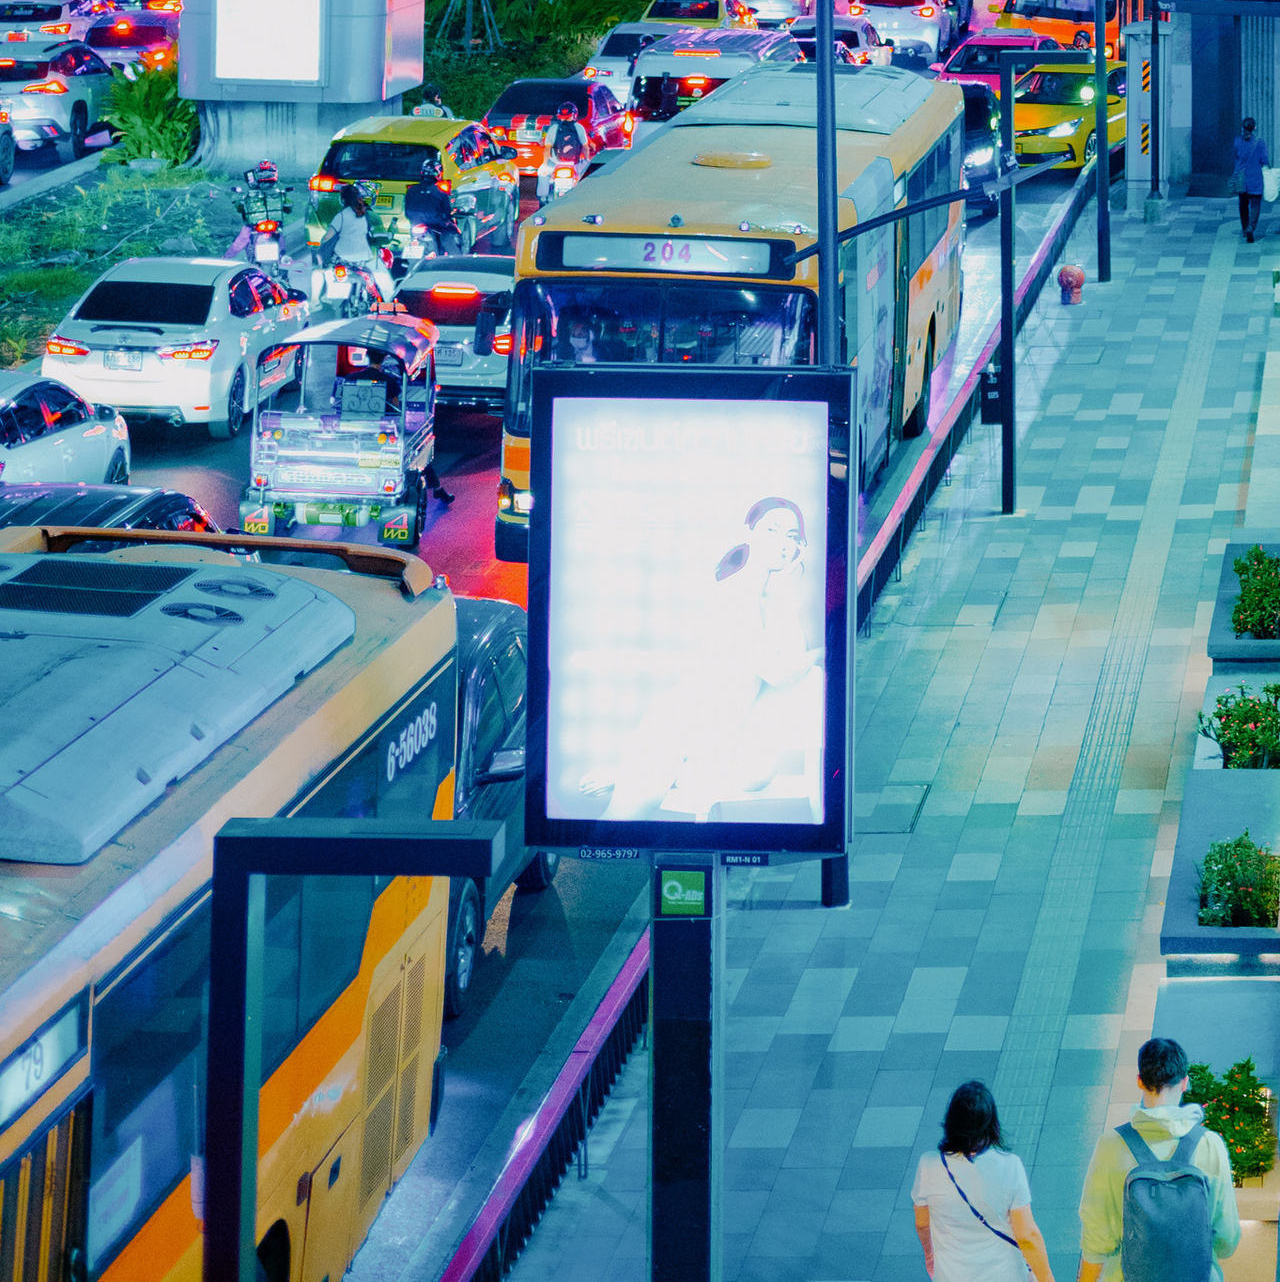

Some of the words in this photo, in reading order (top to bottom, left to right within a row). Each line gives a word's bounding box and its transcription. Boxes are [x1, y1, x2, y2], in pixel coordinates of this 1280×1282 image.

[643, 241, 692, 263] 204
[387, 701, 437, 782] 6-56038
[580, 849, 638, 859] 02-965-9797
